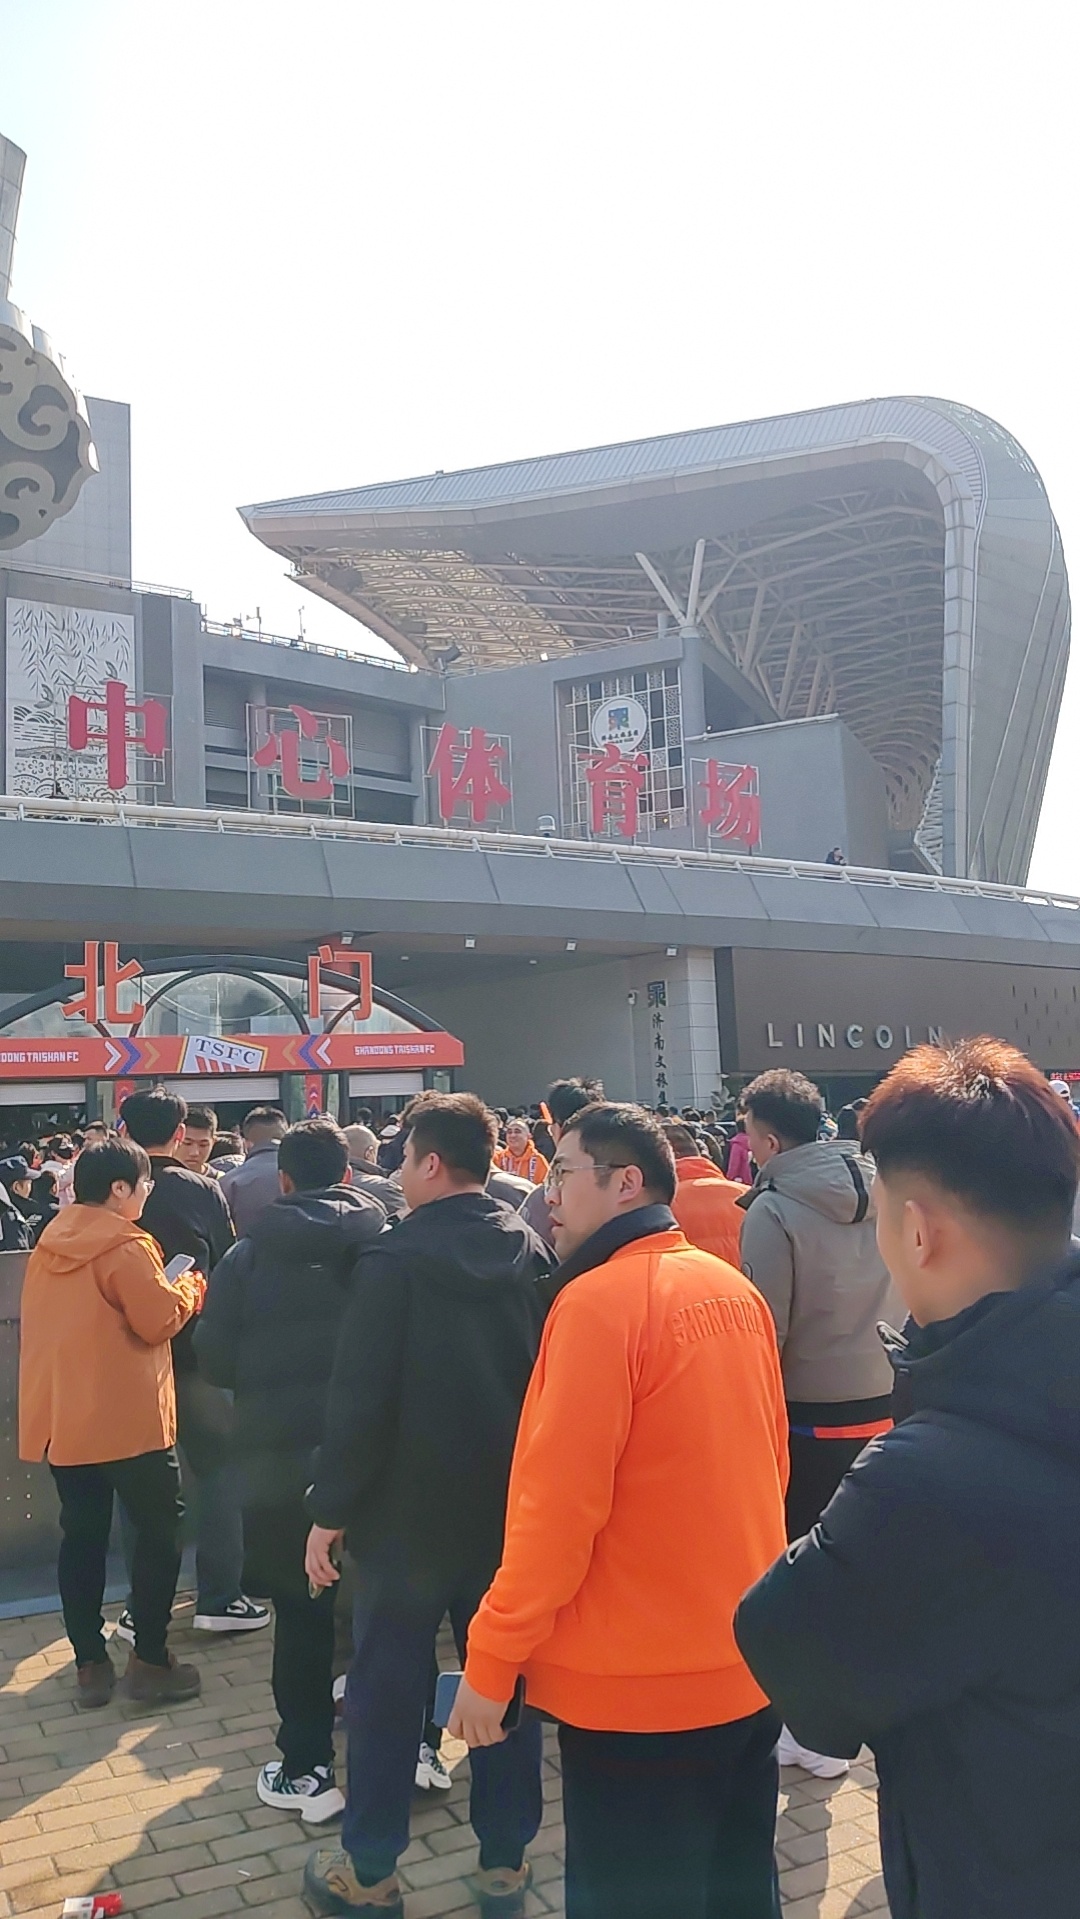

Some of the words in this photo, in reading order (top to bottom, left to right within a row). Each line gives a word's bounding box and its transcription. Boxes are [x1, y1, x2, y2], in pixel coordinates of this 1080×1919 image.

[67, 679, 761, 847] 中心体育场
[62, 940, 374, 1025] 北门
[425, 1044, 435, 1054] FC
[767, 1022, 943, 1049] LINCOLN
[26, 1051, 65, 1063] TAISHAN
[66, 1051, 80, 1062] FC
[195, 1037, 257, 1066] TSFC
